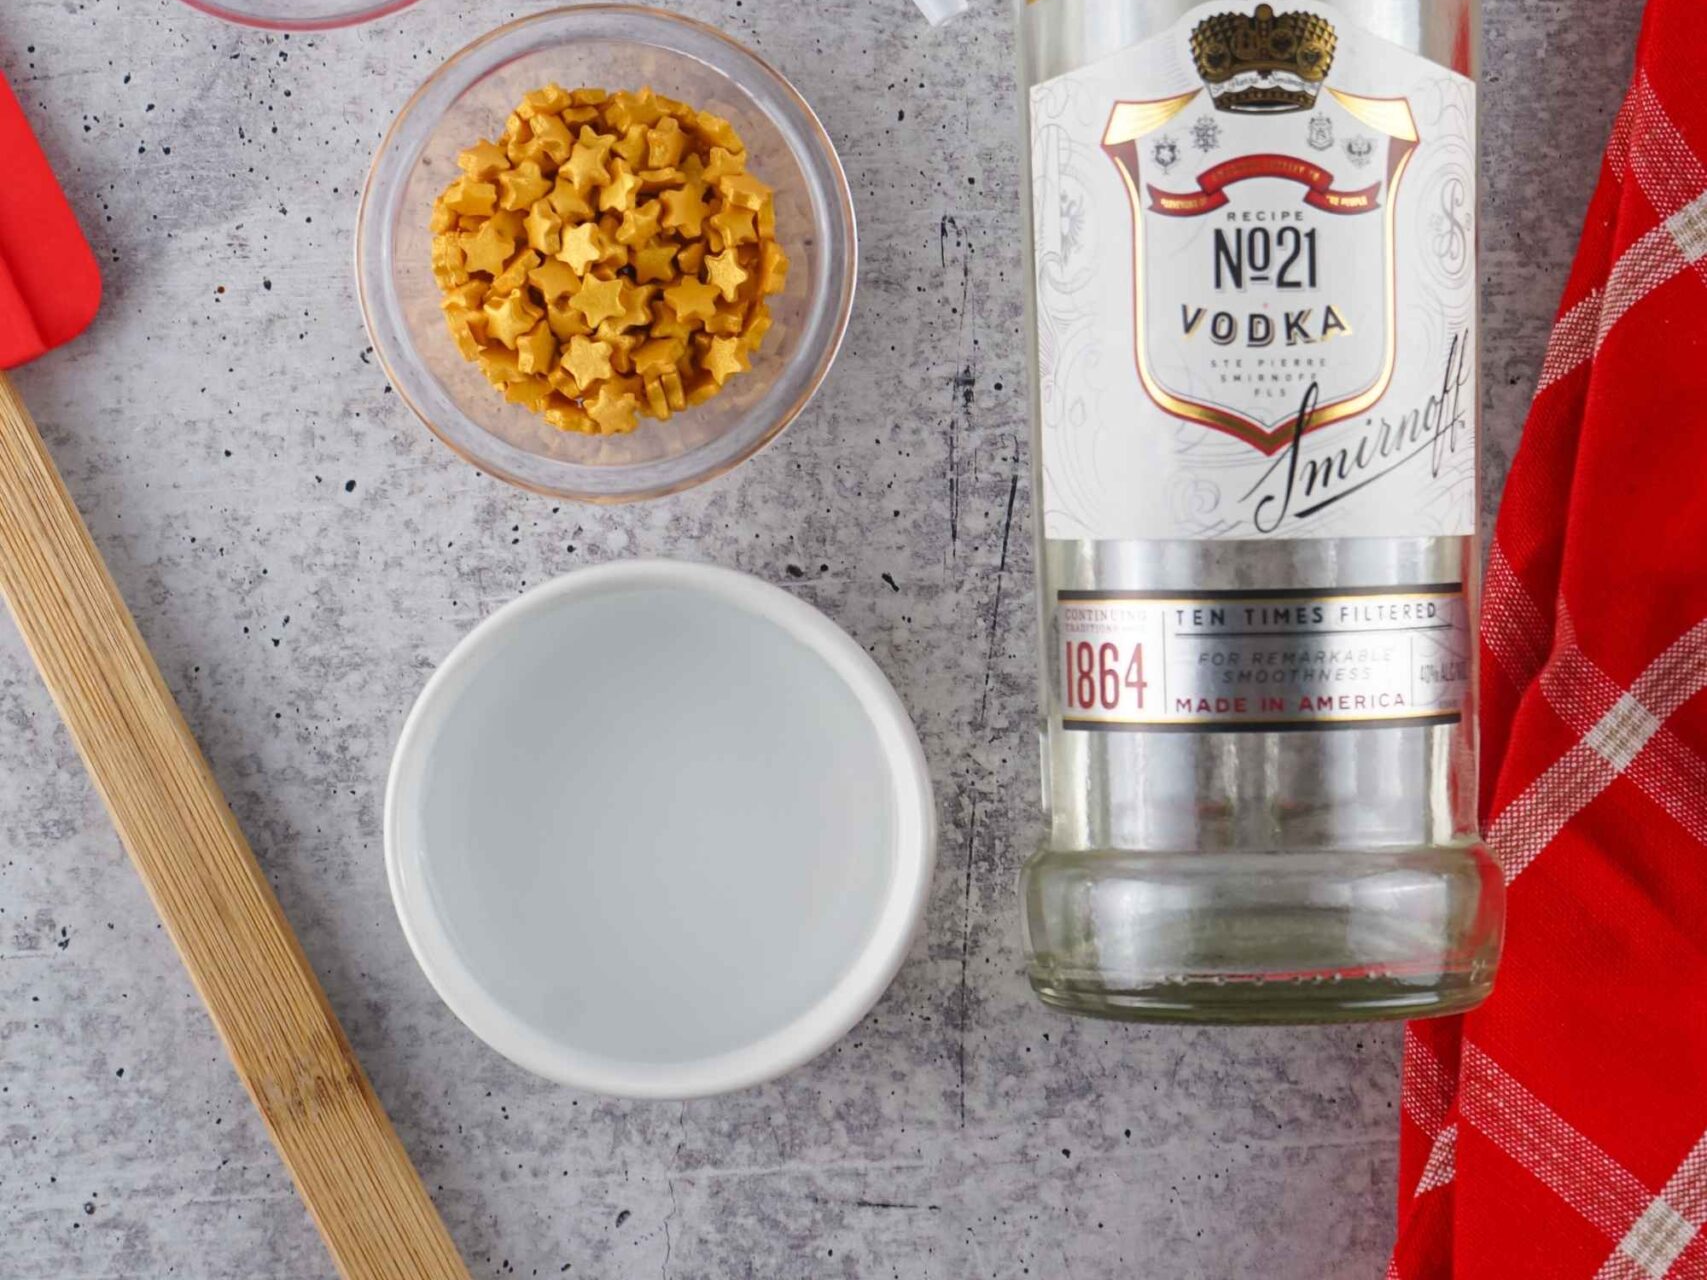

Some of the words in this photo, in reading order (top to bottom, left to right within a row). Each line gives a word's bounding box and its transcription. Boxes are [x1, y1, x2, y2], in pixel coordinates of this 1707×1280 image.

[1226, 211, 1304, 221] RECIPE
[1181, 303, 1350, 347] VODKA
[1211, 359, 1242, 368] STE
[1257, 358, 1327, 368] PIERRE
[1220, 373, 1317, 383] SMIRNOFF
[1254, 388, 1287, 397] FLS
[1238, 328, 1471, 533] Smirnoff
[1175, 609, 1226, 626] TEN
[1245, 607, 1324, 625] TIMES
[1340, 602, 1437, 622] FILTERED
[1198, 651, 1241, 667] FOR
[1252, 648, 1393, 667] REMARKABLE
[1066, 640, 1148, 710] 1864
[1222, 668, 1371, 685] SMOOTHNESS
[1175, 697, 1248, 713] MADE
[1261, 696, 1285, 713] IN
[1301, 693, 1406, 712] AMERICA
